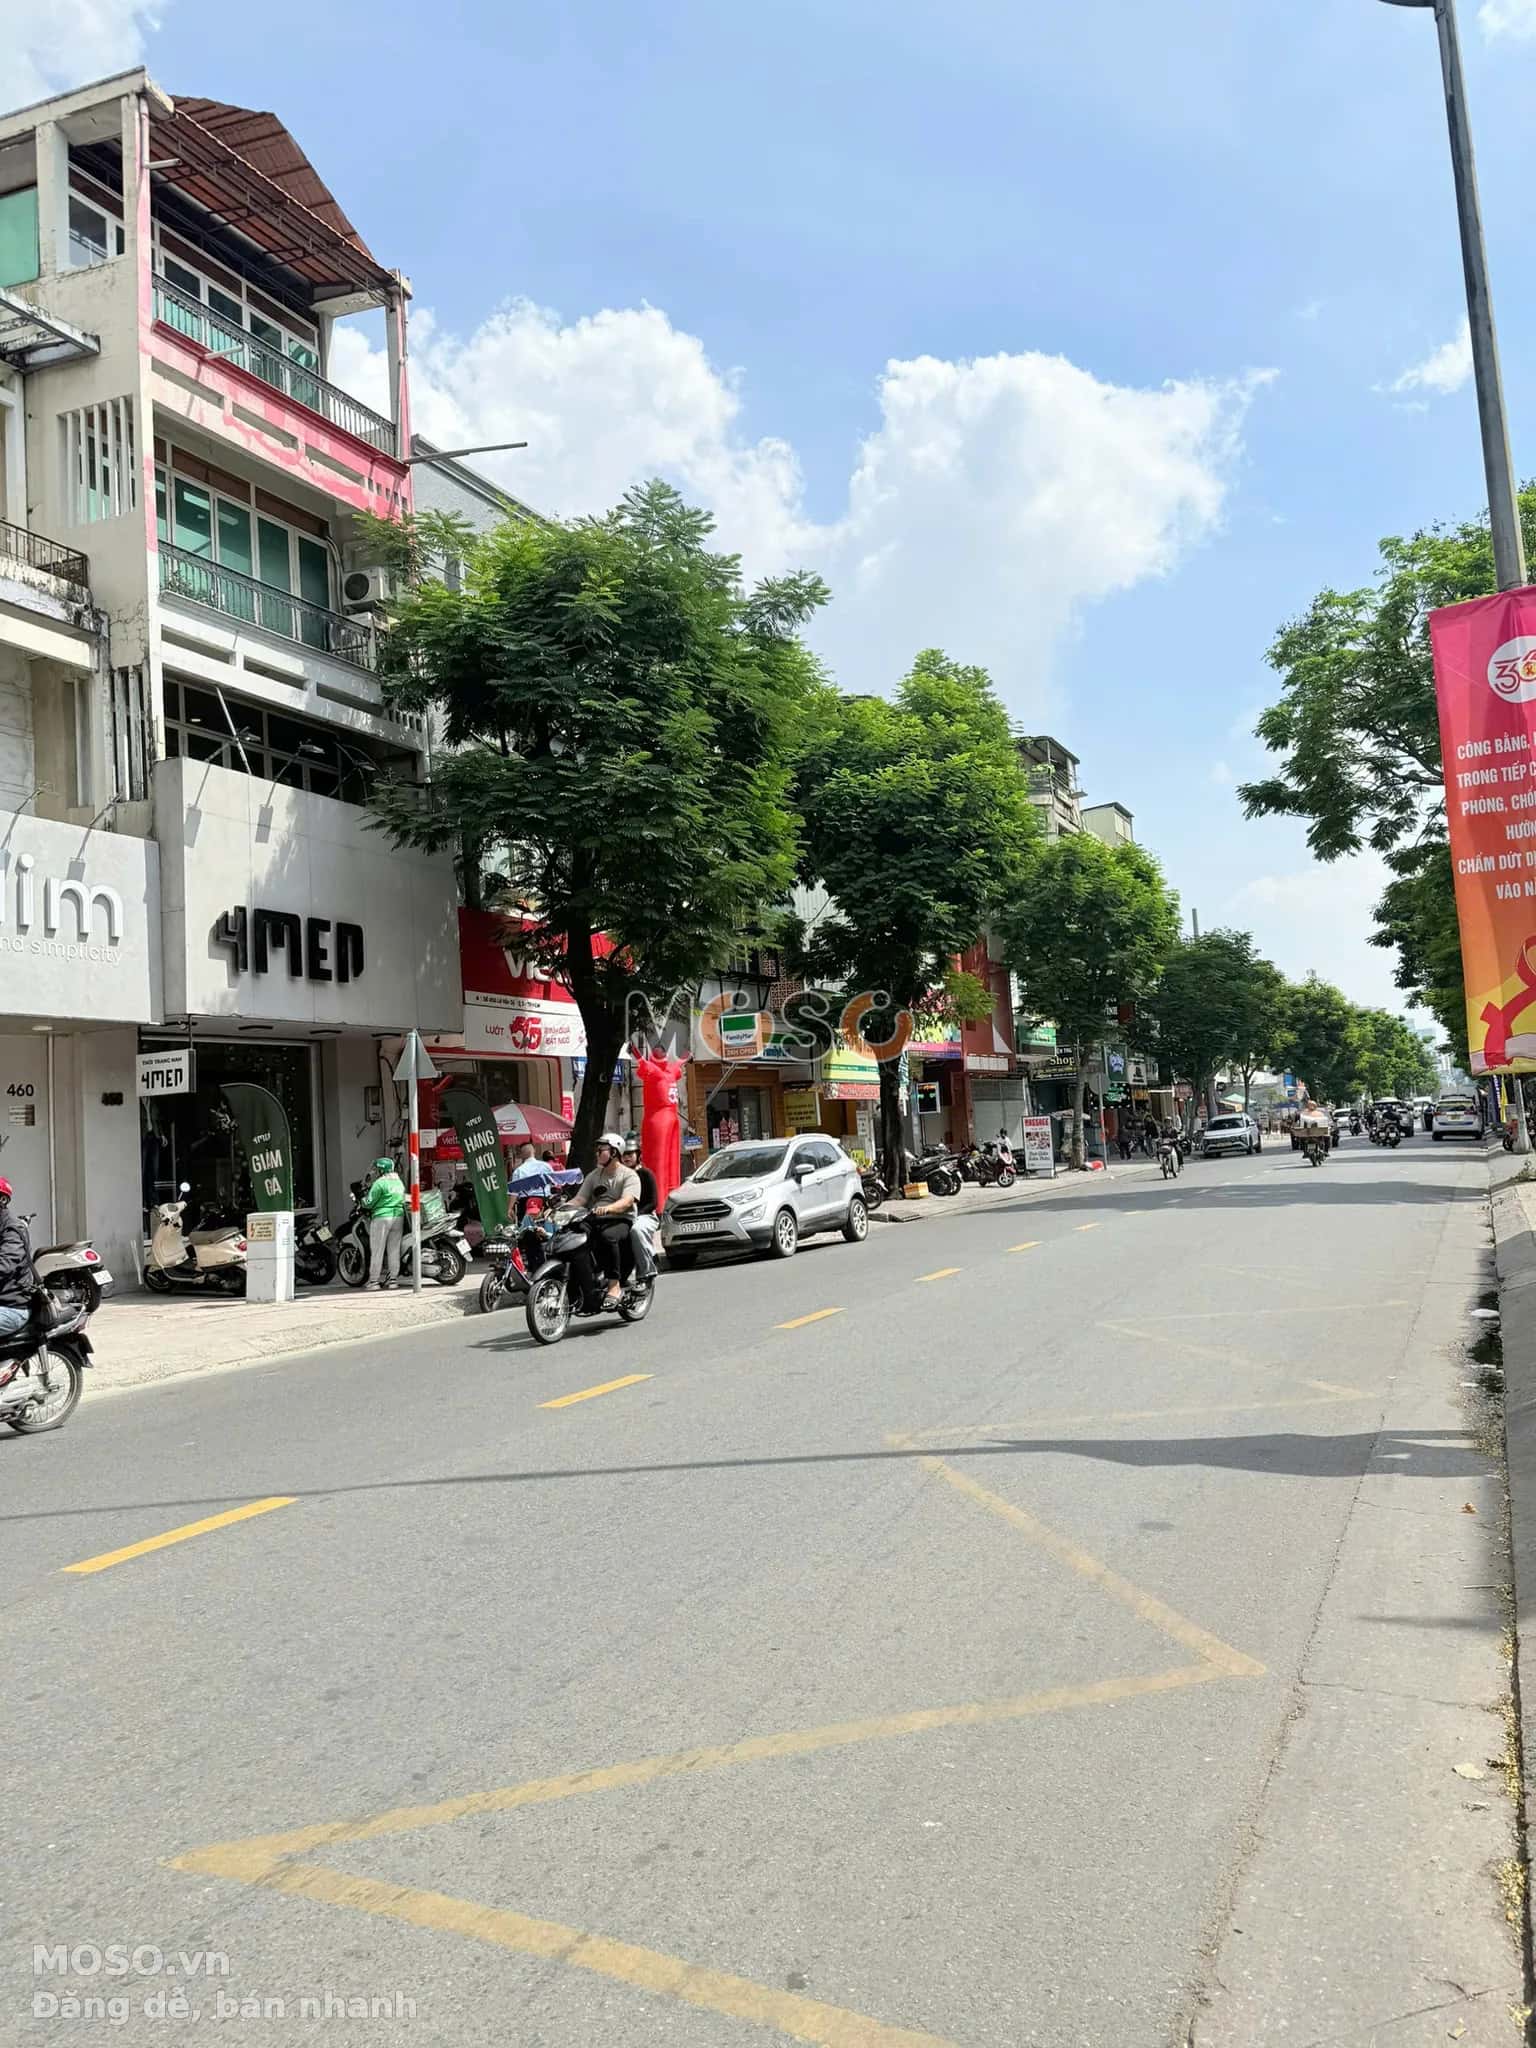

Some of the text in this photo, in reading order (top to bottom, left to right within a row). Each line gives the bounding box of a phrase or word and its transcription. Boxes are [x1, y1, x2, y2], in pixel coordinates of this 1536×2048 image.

[1457, 740, 1492, 760] CÔNG
[1495, 731, 1530, 754] BẰNG,
[1456, 767, 1498, 789] TRONG
[1501, 760, 1527, 782] TIẾP
[1461, 796, 1508, 816] PHÒNG,
[1458, 852, 1495, 874] CHẤM
[1499, 851, 1522, 870] DỨT
[1496, 881, 1521, 899] VÀO
[216, 905, 364, 983] 4MEN
[1050, 1055, 1075, 1066] Shop
[141, 1068, 183, 1089] 4MEN
[6, 1083, 34, 1097] 460
